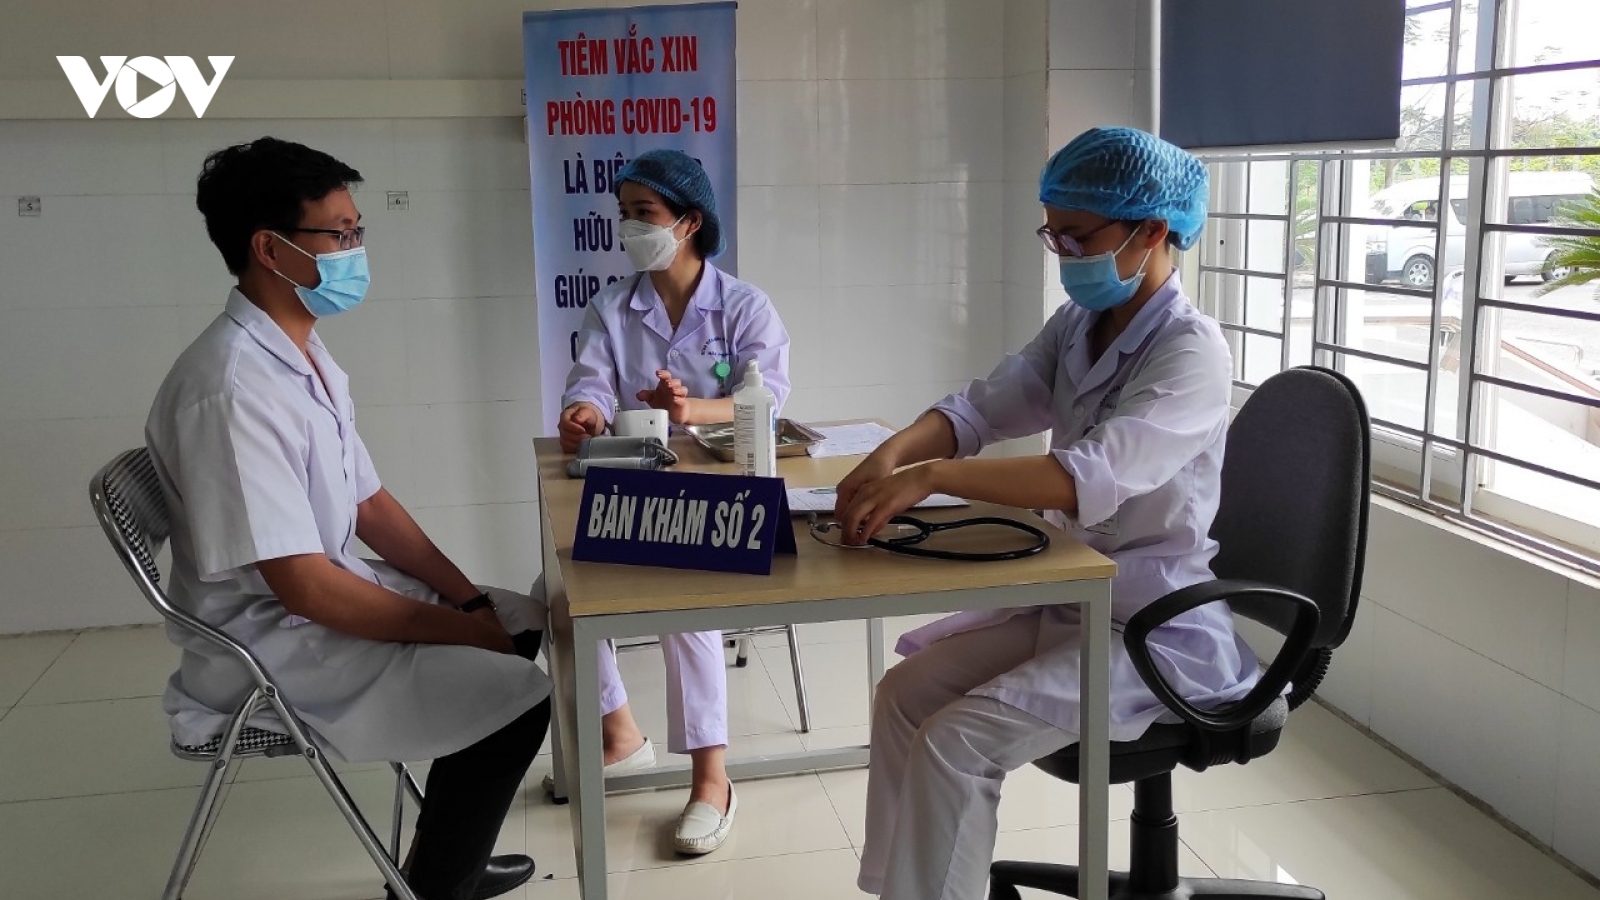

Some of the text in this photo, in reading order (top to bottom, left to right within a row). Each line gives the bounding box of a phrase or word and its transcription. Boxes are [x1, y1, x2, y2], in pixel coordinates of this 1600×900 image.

[558, 23, 697, 76] TIÊM VẮC XIN
[547, 91, 716, 136] PHÒNG COVID-19
[564, 152, 589, 194] LÀ
[573, 210, 613, 252] HỮU
[587, 485, 766, 550] BÀN KHÁM SỐ 2
